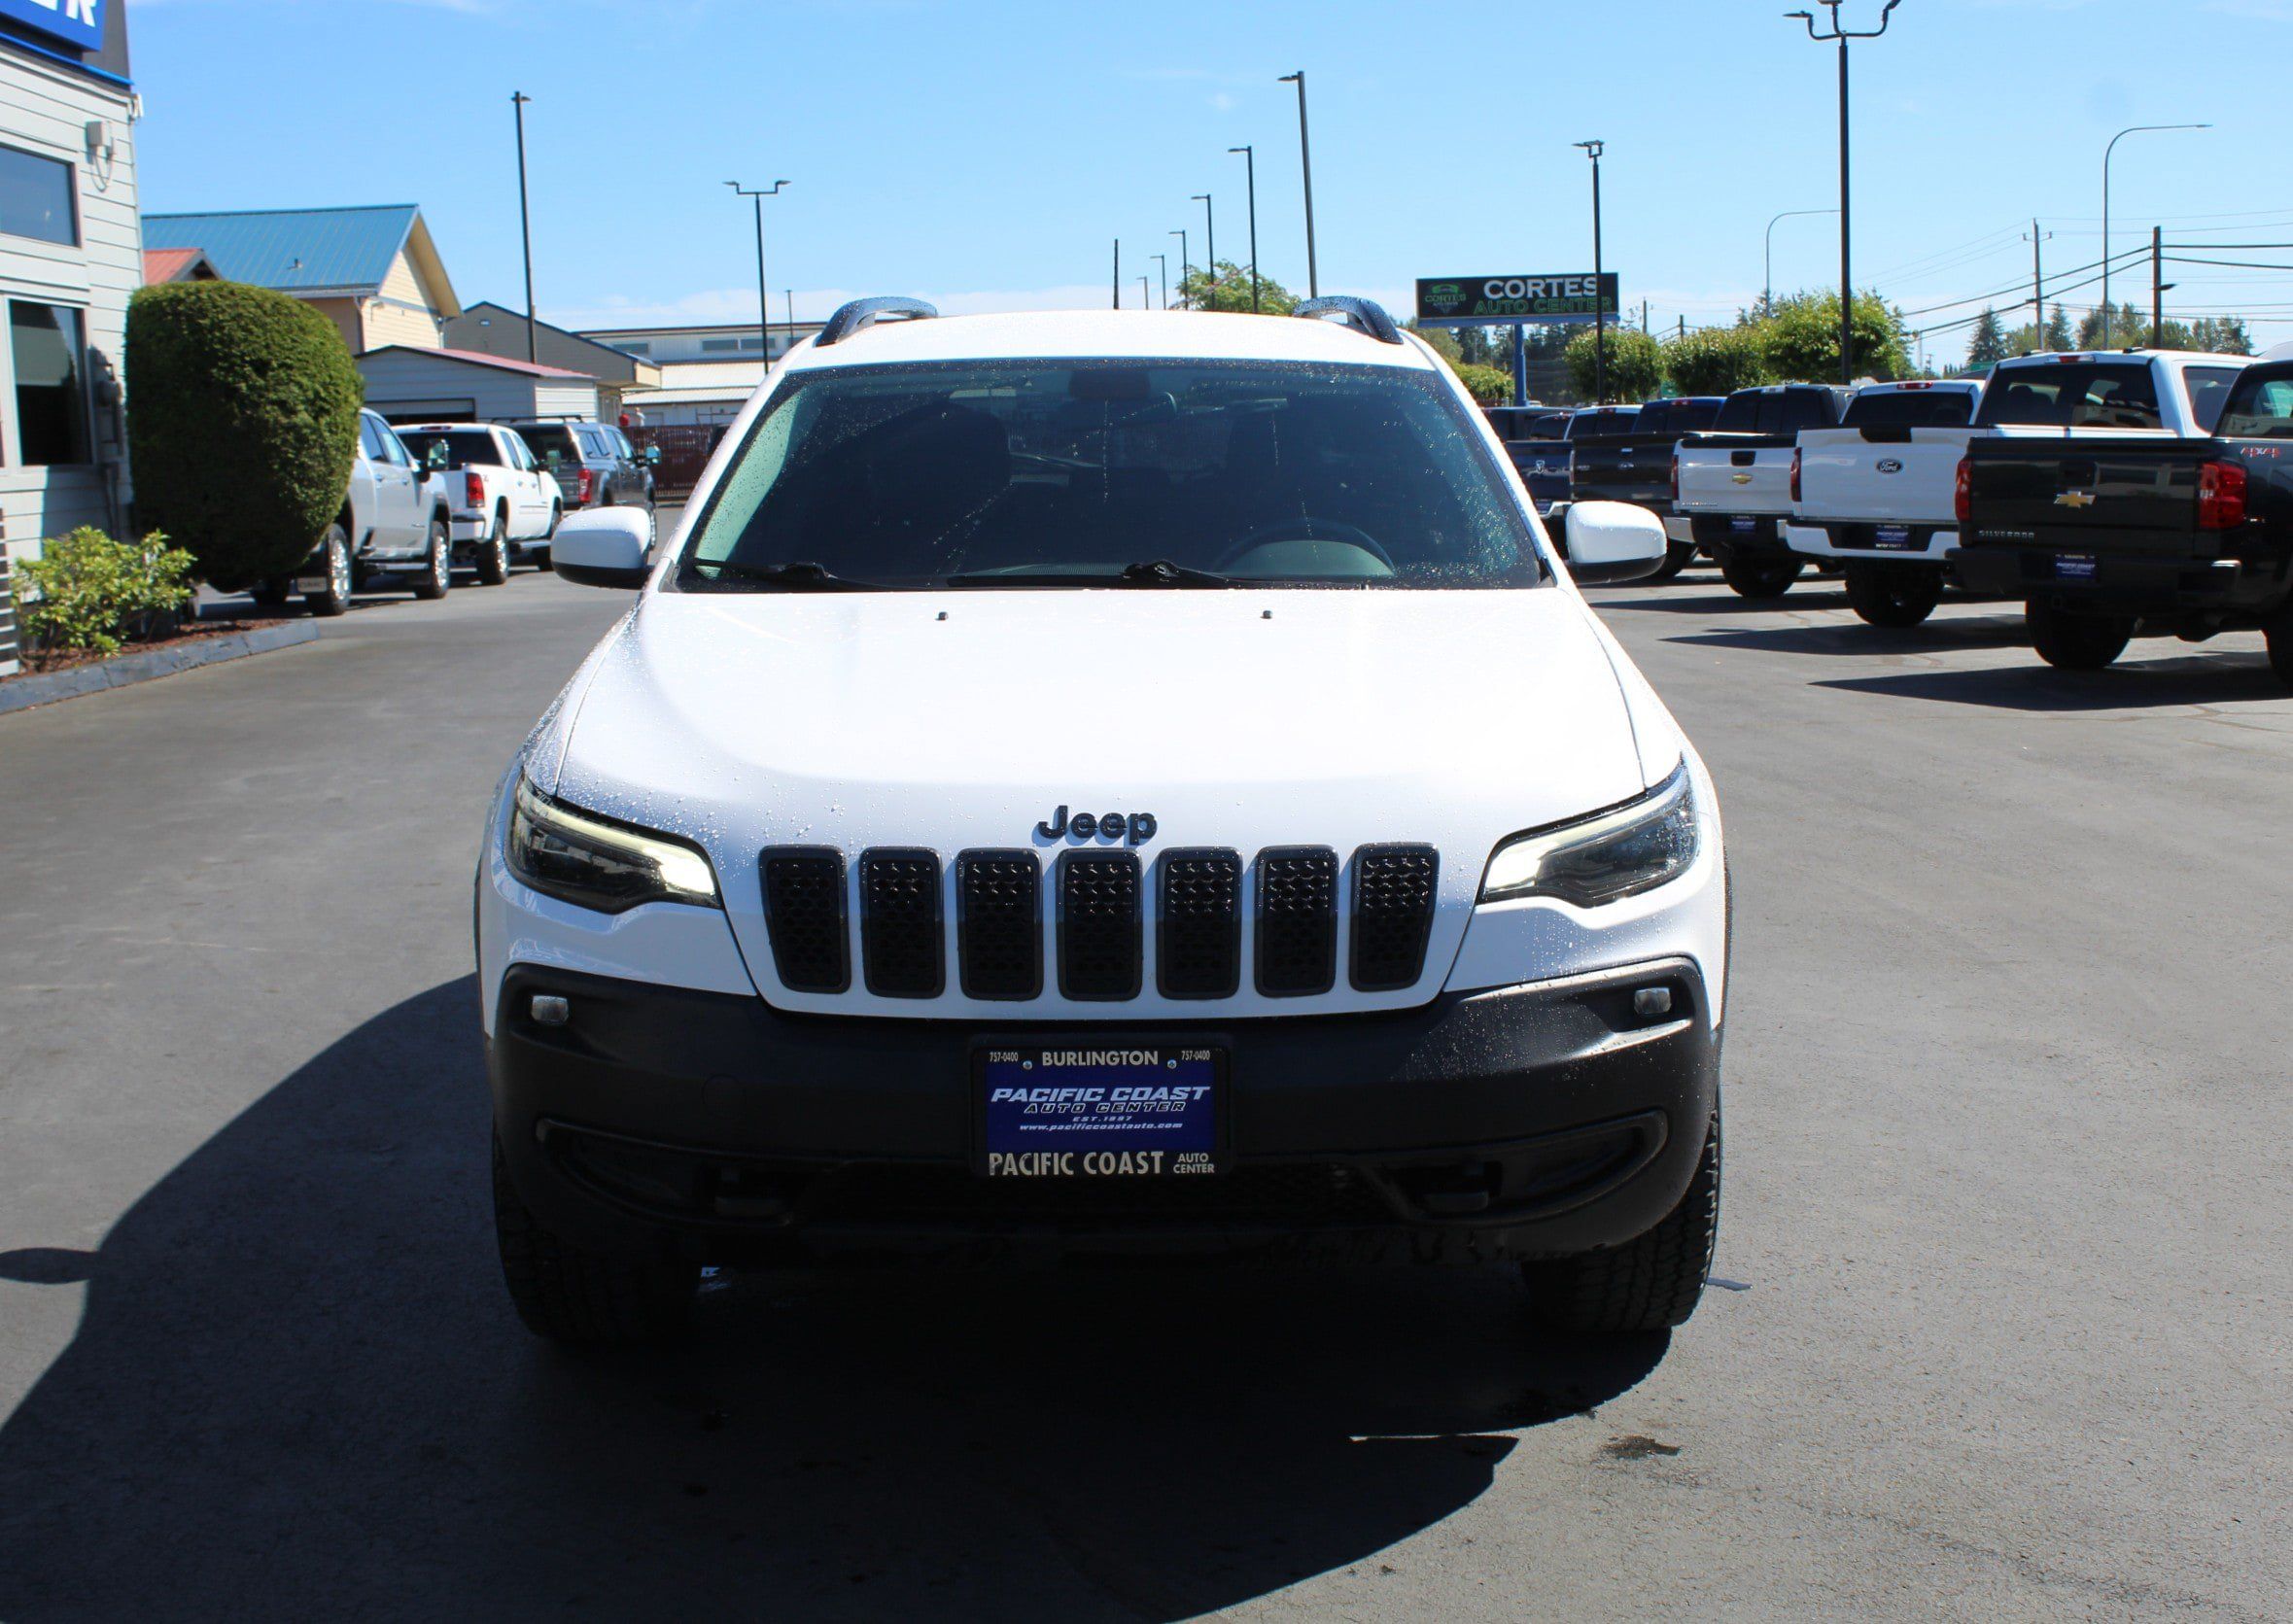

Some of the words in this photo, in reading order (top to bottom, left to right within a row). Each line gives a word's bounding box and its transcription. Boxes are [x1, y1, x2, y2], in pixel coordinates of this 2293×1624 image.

[1483, 276, 1597, 298] CORTES
[1473, 297, 1530, 316] AUTO
[1533, 296, 1613, 314] CENTER
[1037, 805, 1158, 846] Jeep
[989, 1051, 1019, 1062] 757-0400
[1041, 1050, 1159, 1067] BURLINGTON
[1181, 1049, 1211, 1061] 757-0400
[990, 1087, 1108, 1103] PACIFIC
[1109, 1086, 1211, 1101] COAST
[1024, 1102, 1087, 1114] AUTO
[1095, 1101, 1187, 1113] CENTER
[1019, 1122, 1184, 1131] www.pacificcoastauto.com
[988, 1152, 1075, 1176] PACIFIC
[1083, 1151, 1164, 1175] COAST
[1177, 1153, 1210, 1163] AUTO
[1172, 1163, 1215, 1174] CENTER
